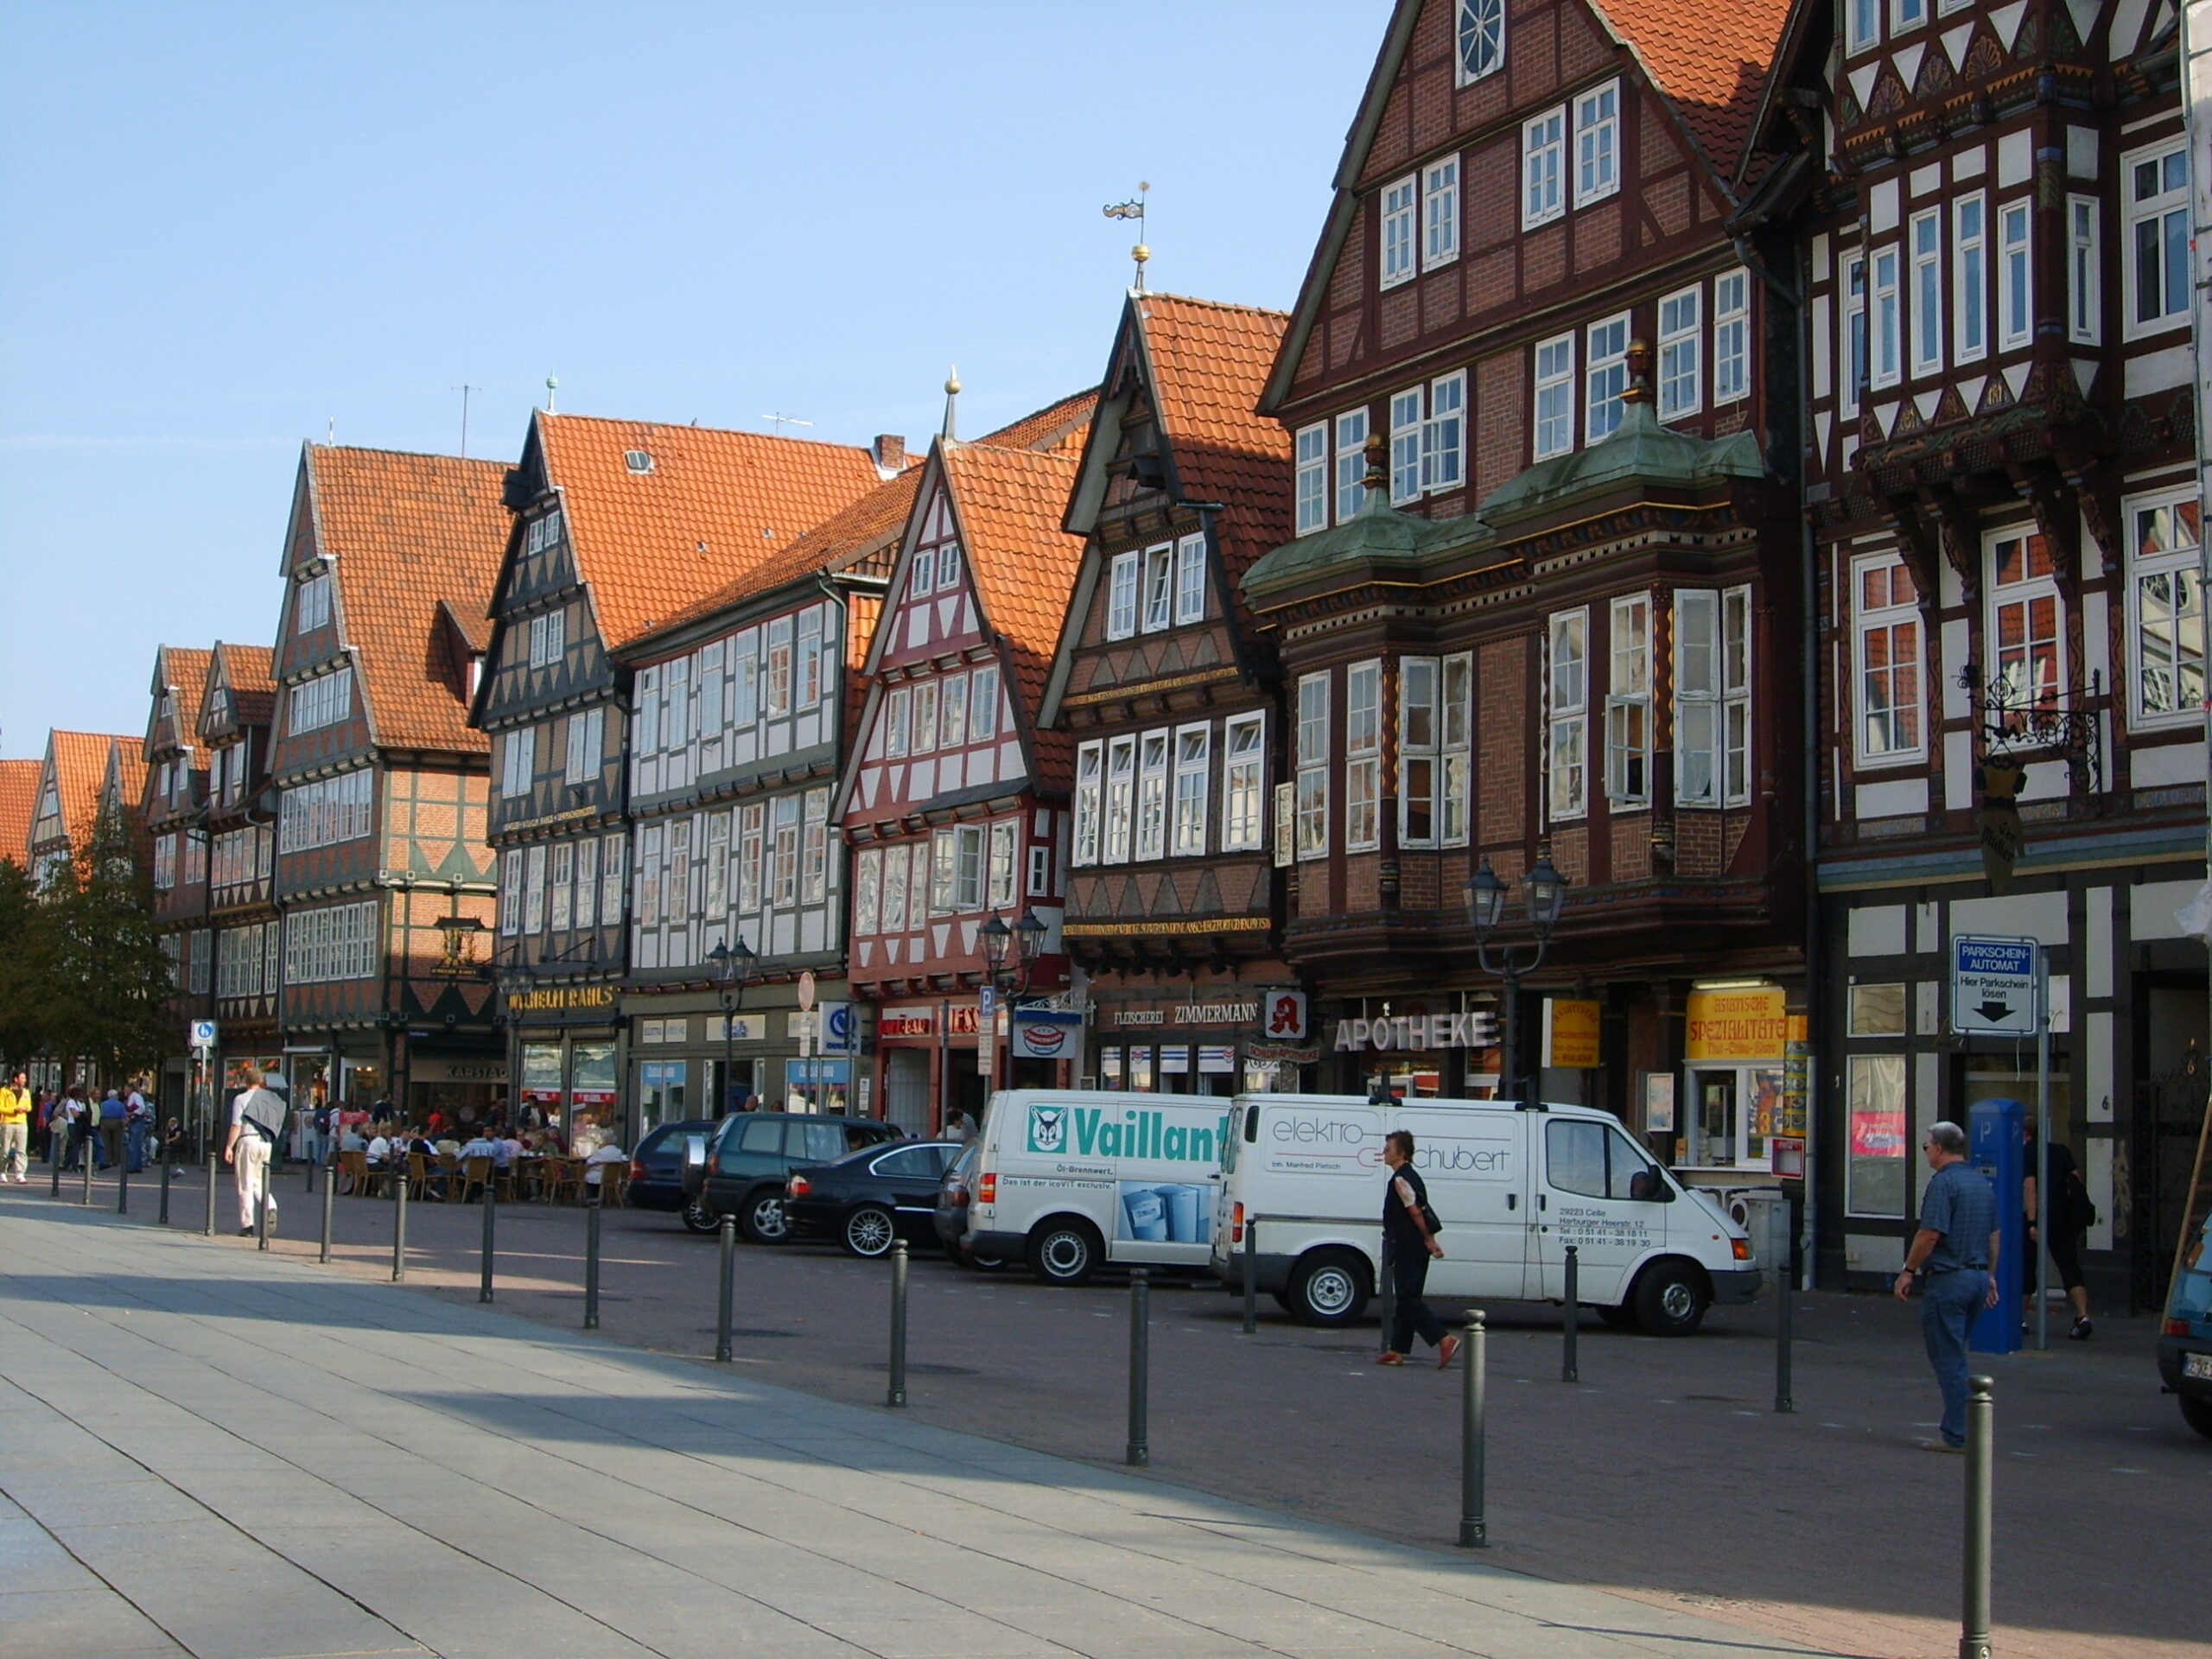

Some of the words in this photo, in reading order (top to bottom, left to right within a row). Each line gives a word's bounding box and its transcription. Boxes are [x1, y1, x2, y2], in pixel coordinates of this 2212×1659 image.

[1961, 945, 2029, 959] PARKSCHEIN-
[1970, 958, 2020, 971] AUTOMAT
[1961, 976, 1978, 986] Hier
[1980, 976, 2029, 989] Parkschein
[1981, 988, 2006, 999] lösen
[1714, 995, 1769, 1014] ASIATISCHE
[1114, 1010, 1164, 1026] FLEISCHEREI
[1174, 1002, 1258, 1024] ZIMMERMANN
[1334, 1012, 1497, 1052] APOTHEKE
[446, 1066, 510, 1079] KARSTAD
[2101, 1096, 2109, 1110] 6
[1074, 1108, 1228, 1162] Vaillant
[1273, 1117, 1363, 1144] elektro
[1980, 1121, 1992, 1143] P
[1286, 1160, 1314, 1169] Manfred
[1411, 1145, 1510, 1172] chubert
[1559, 1207, 1584, 1216] 29223
[1559, 1217, 1599, 1227] Harburger
